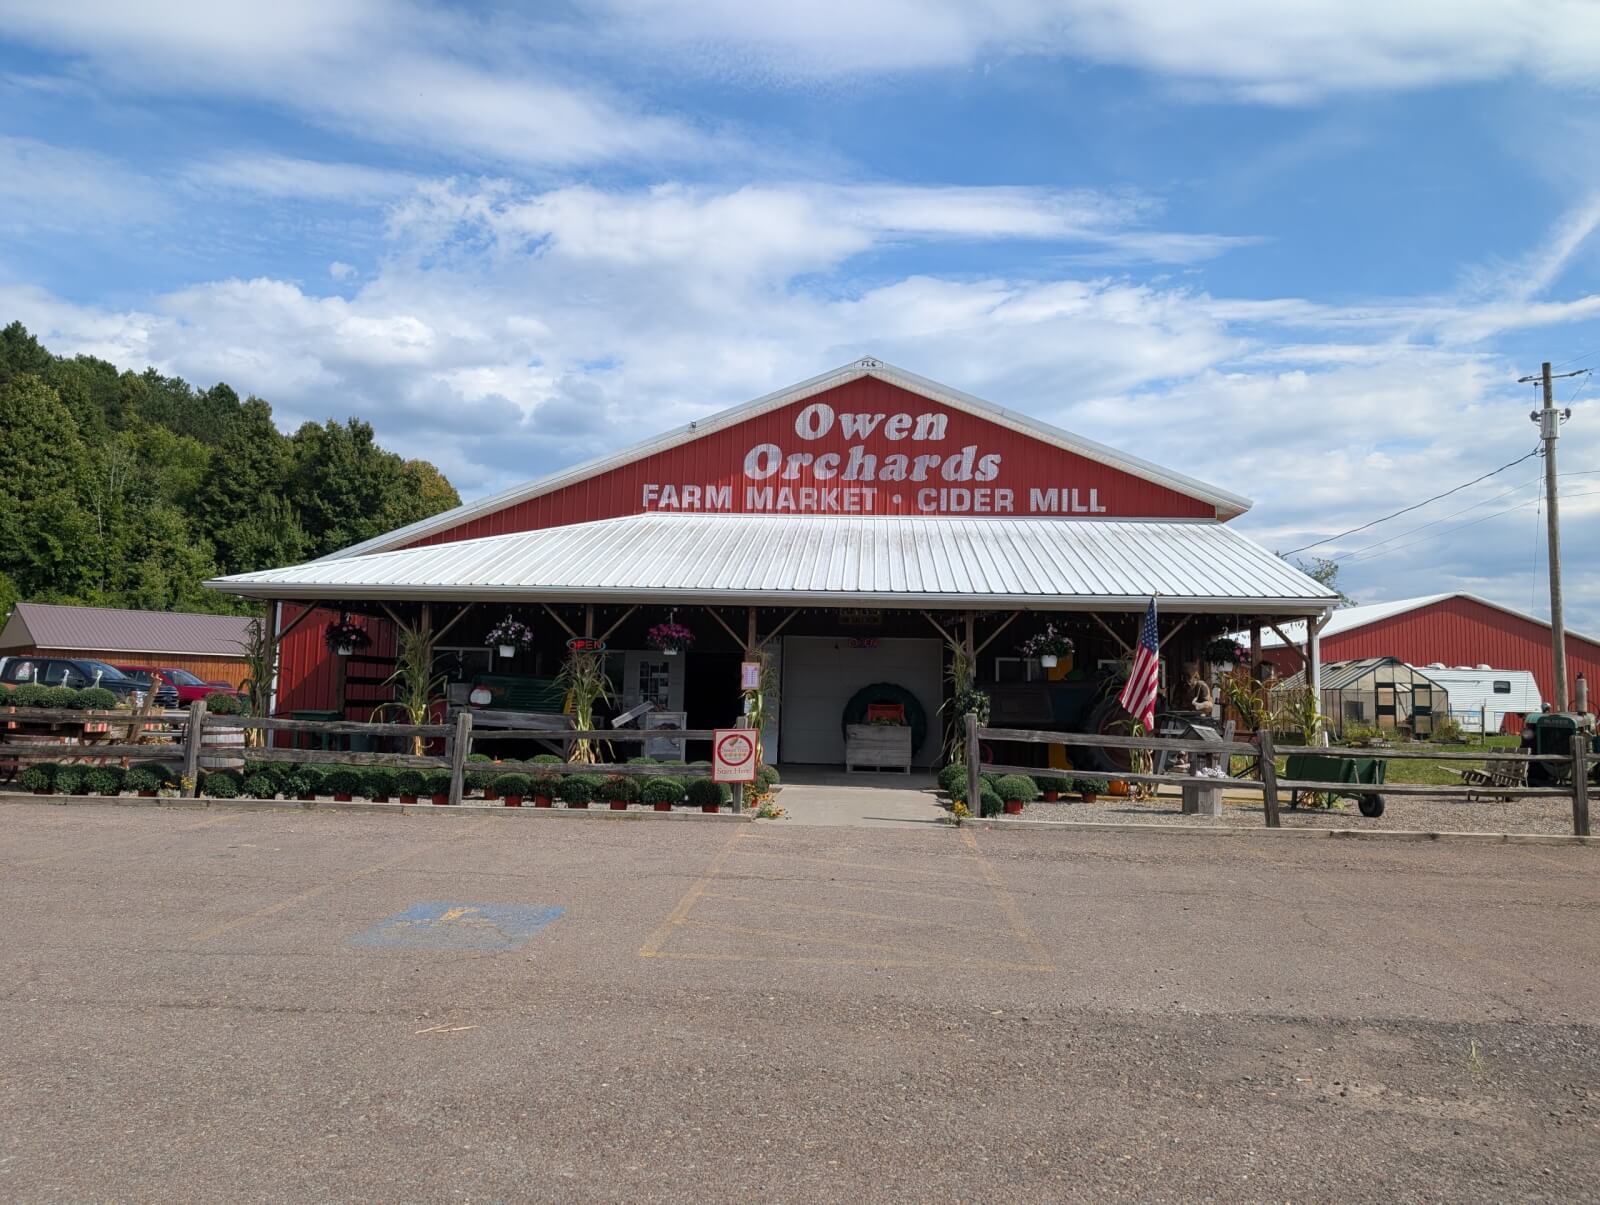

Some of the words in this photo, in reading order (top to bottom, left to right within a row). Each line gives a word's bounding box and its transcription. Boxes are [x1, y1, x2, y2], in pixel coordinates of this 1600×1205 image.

[794, 403, 949, 441] Owen
[743, 443, 1002, 482] Orchards
[642, 483, 733, 510] FARM
[746, 486, 878, 512] MARKET
[917, 488, 1014, 512] CIDER
[1029, 488, 1107, 513] MILL
[569, 640, 602, 650] OPEN
